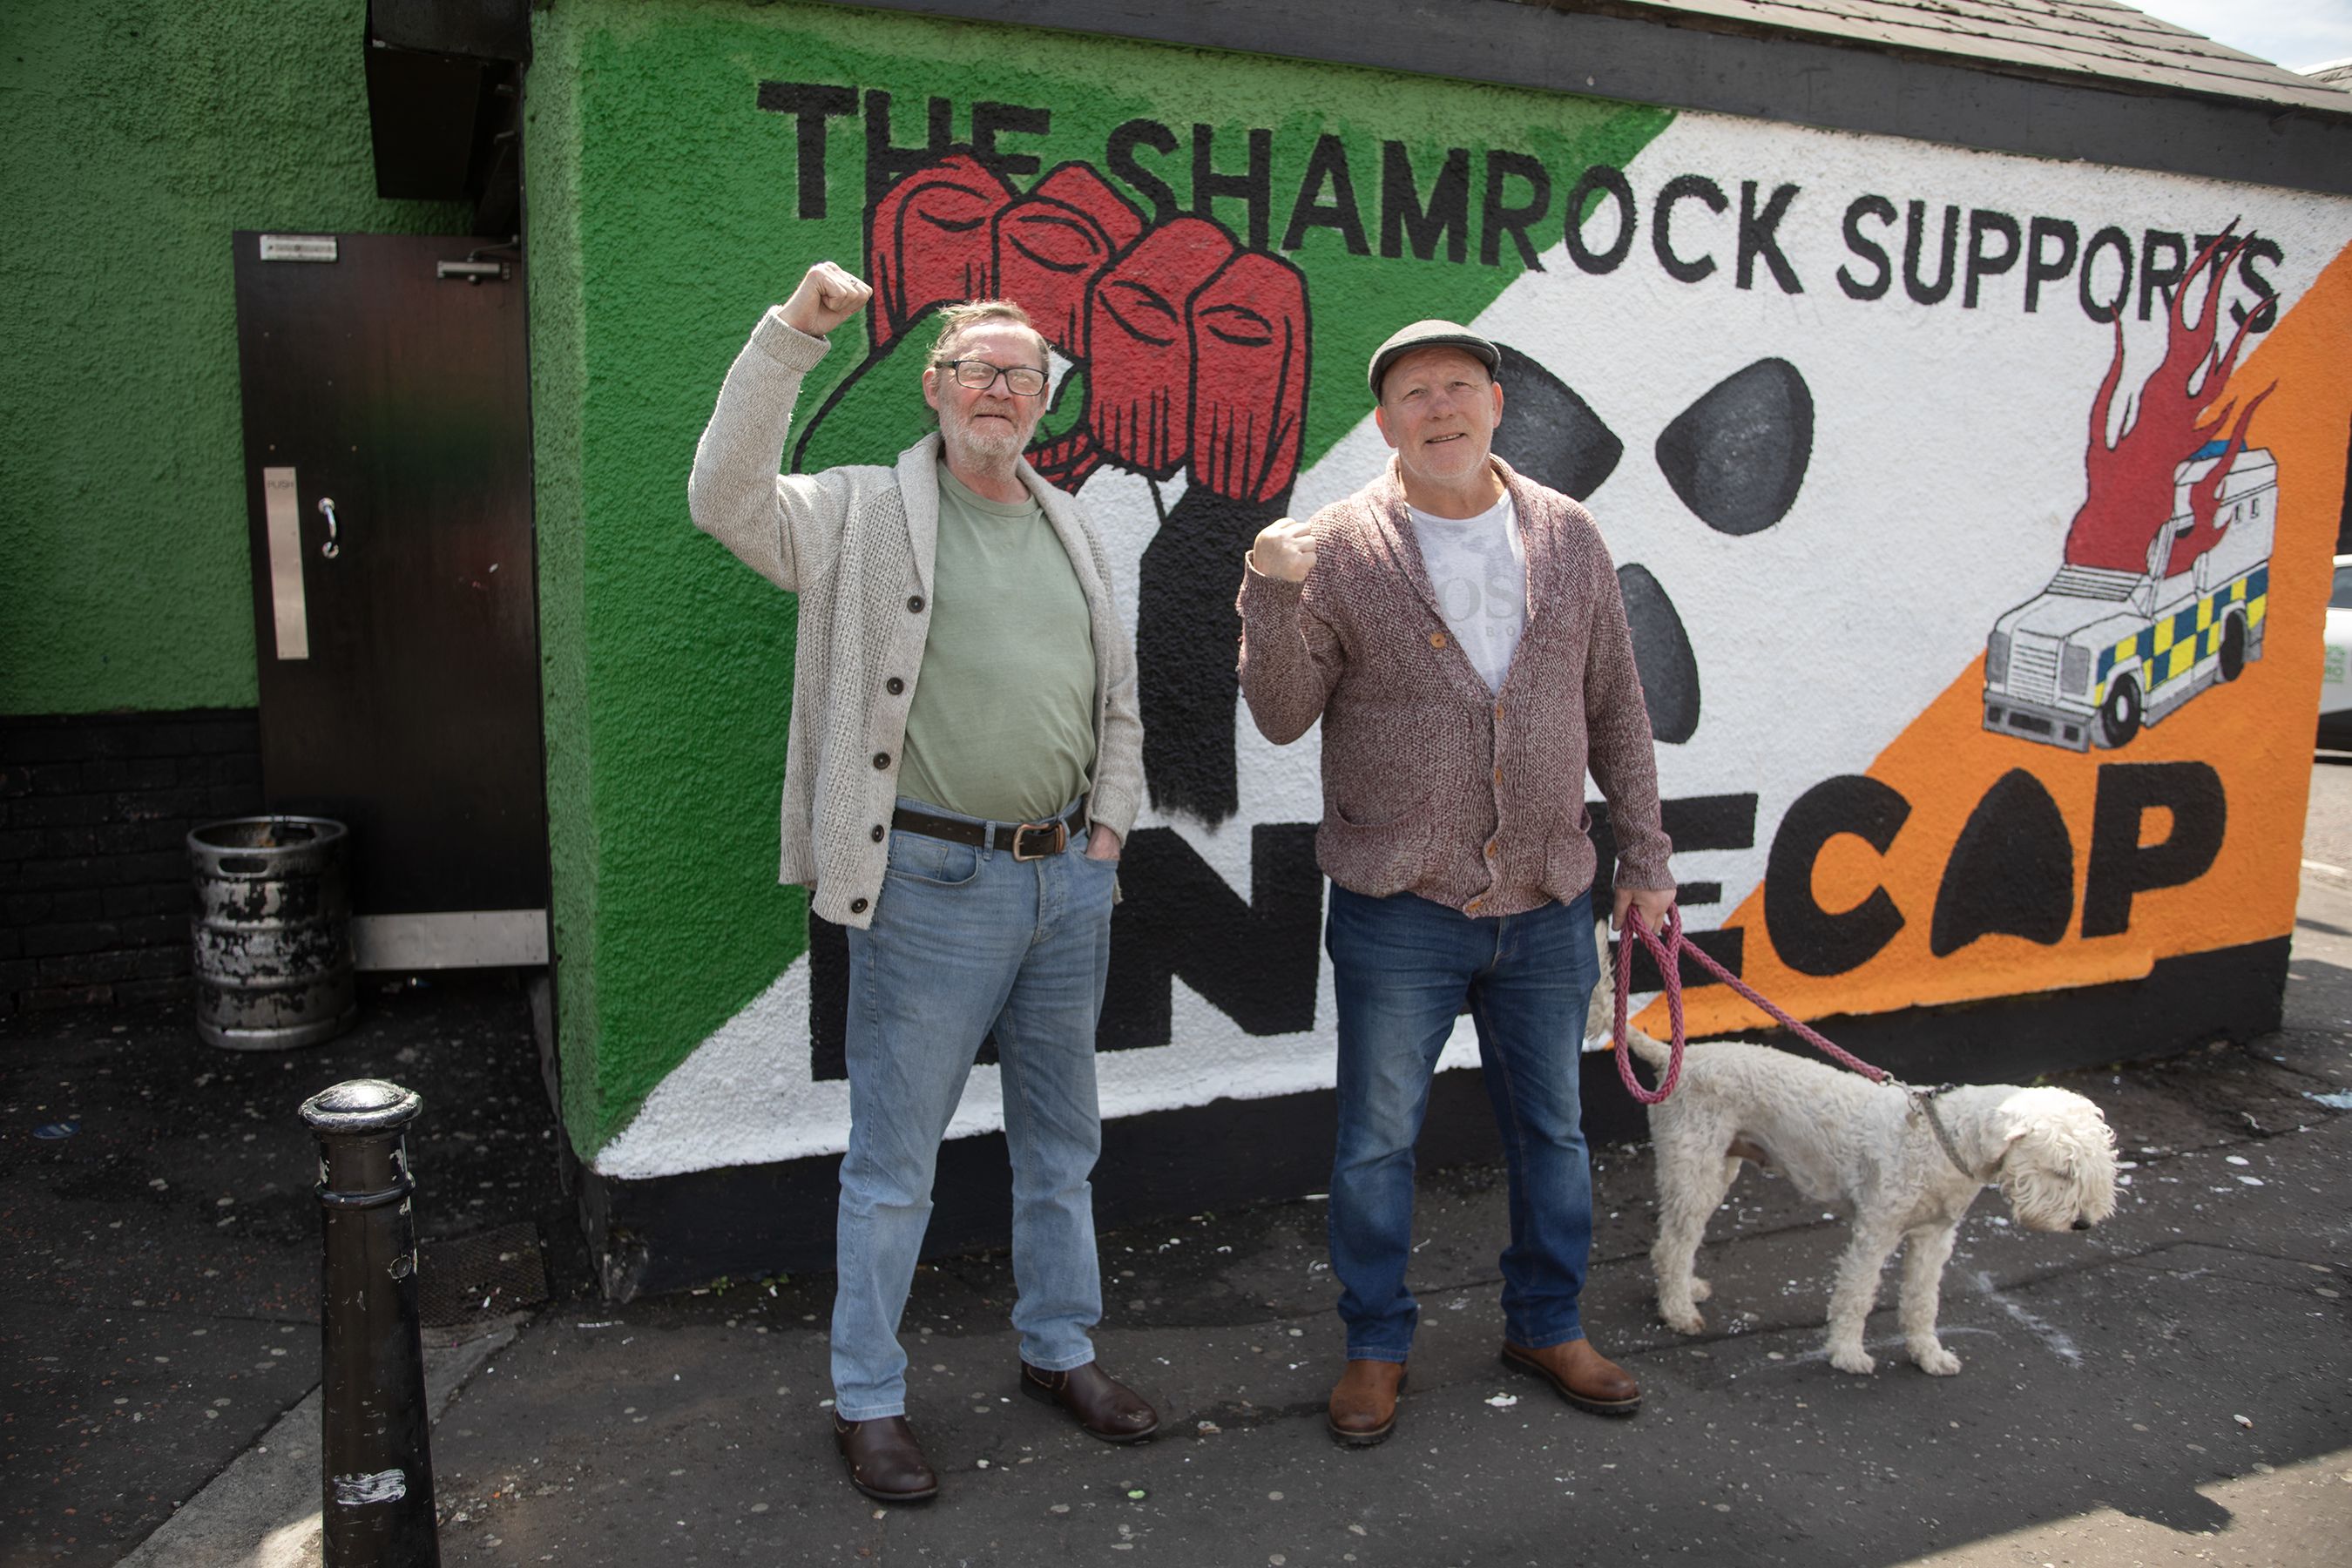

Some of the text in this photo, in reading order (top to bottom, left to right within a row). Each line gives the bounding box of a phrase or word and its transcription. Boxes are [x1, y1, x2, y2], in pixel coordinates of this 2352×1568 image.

[756, 82, 2286, 334] THE SHAMROCK SUPPORTS
[809, 760, 2227, 1081] NECAP
